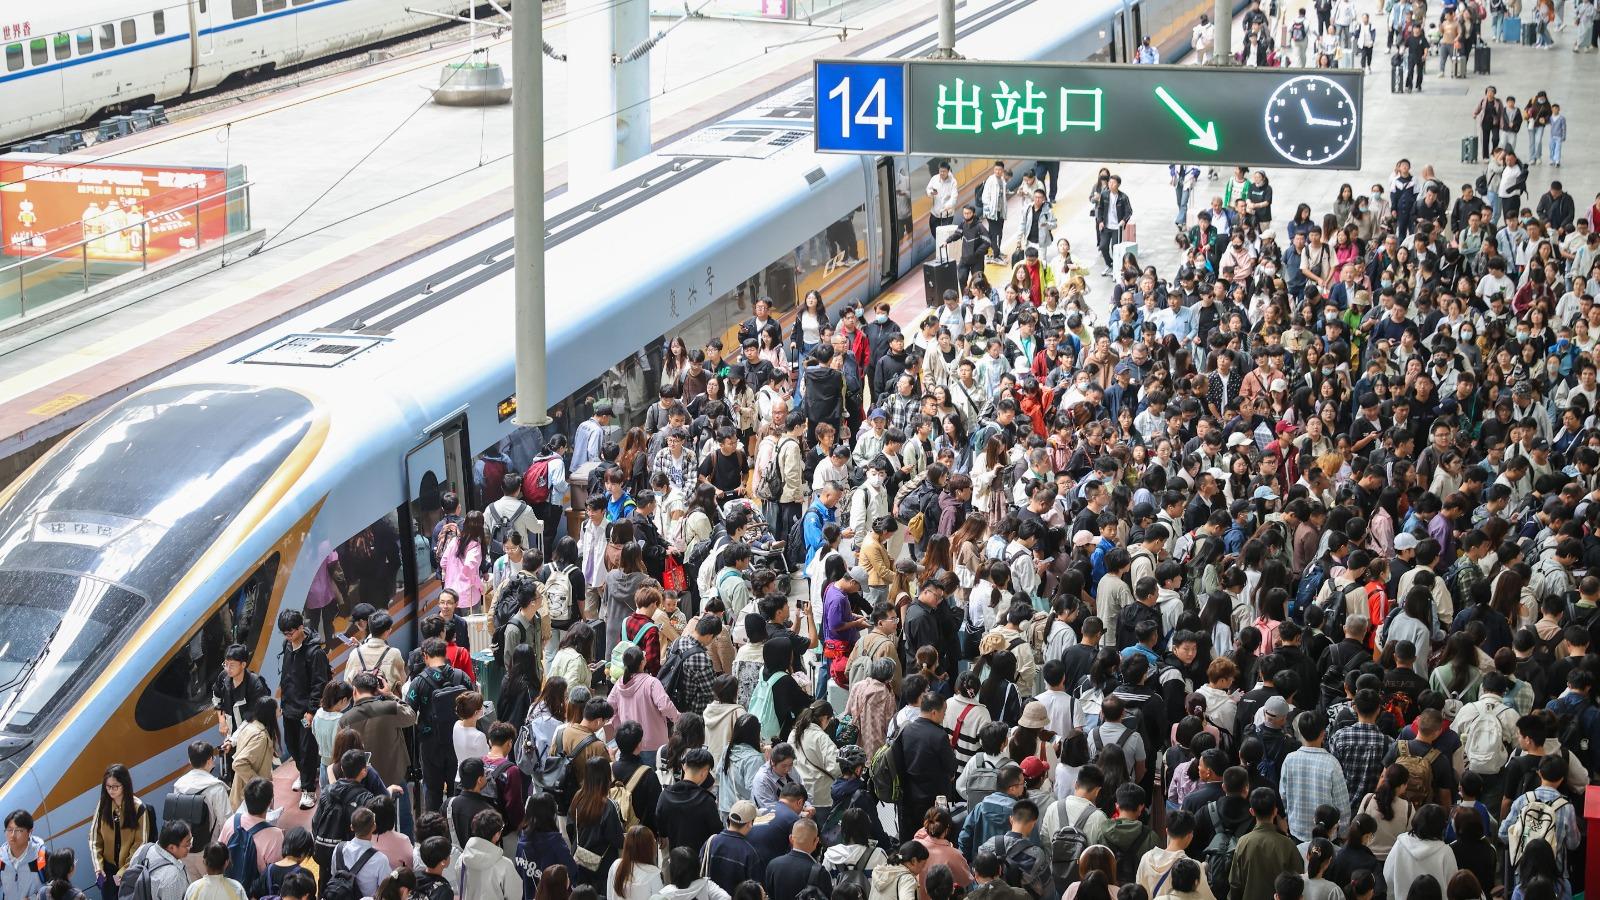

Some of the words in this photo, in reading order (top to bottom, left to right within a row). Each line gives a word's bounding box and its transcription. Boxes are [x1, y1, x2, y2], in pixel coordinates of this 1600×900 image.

[829, 76, 893, 139] 14
[935, 77, 1103, 135] 出站口
